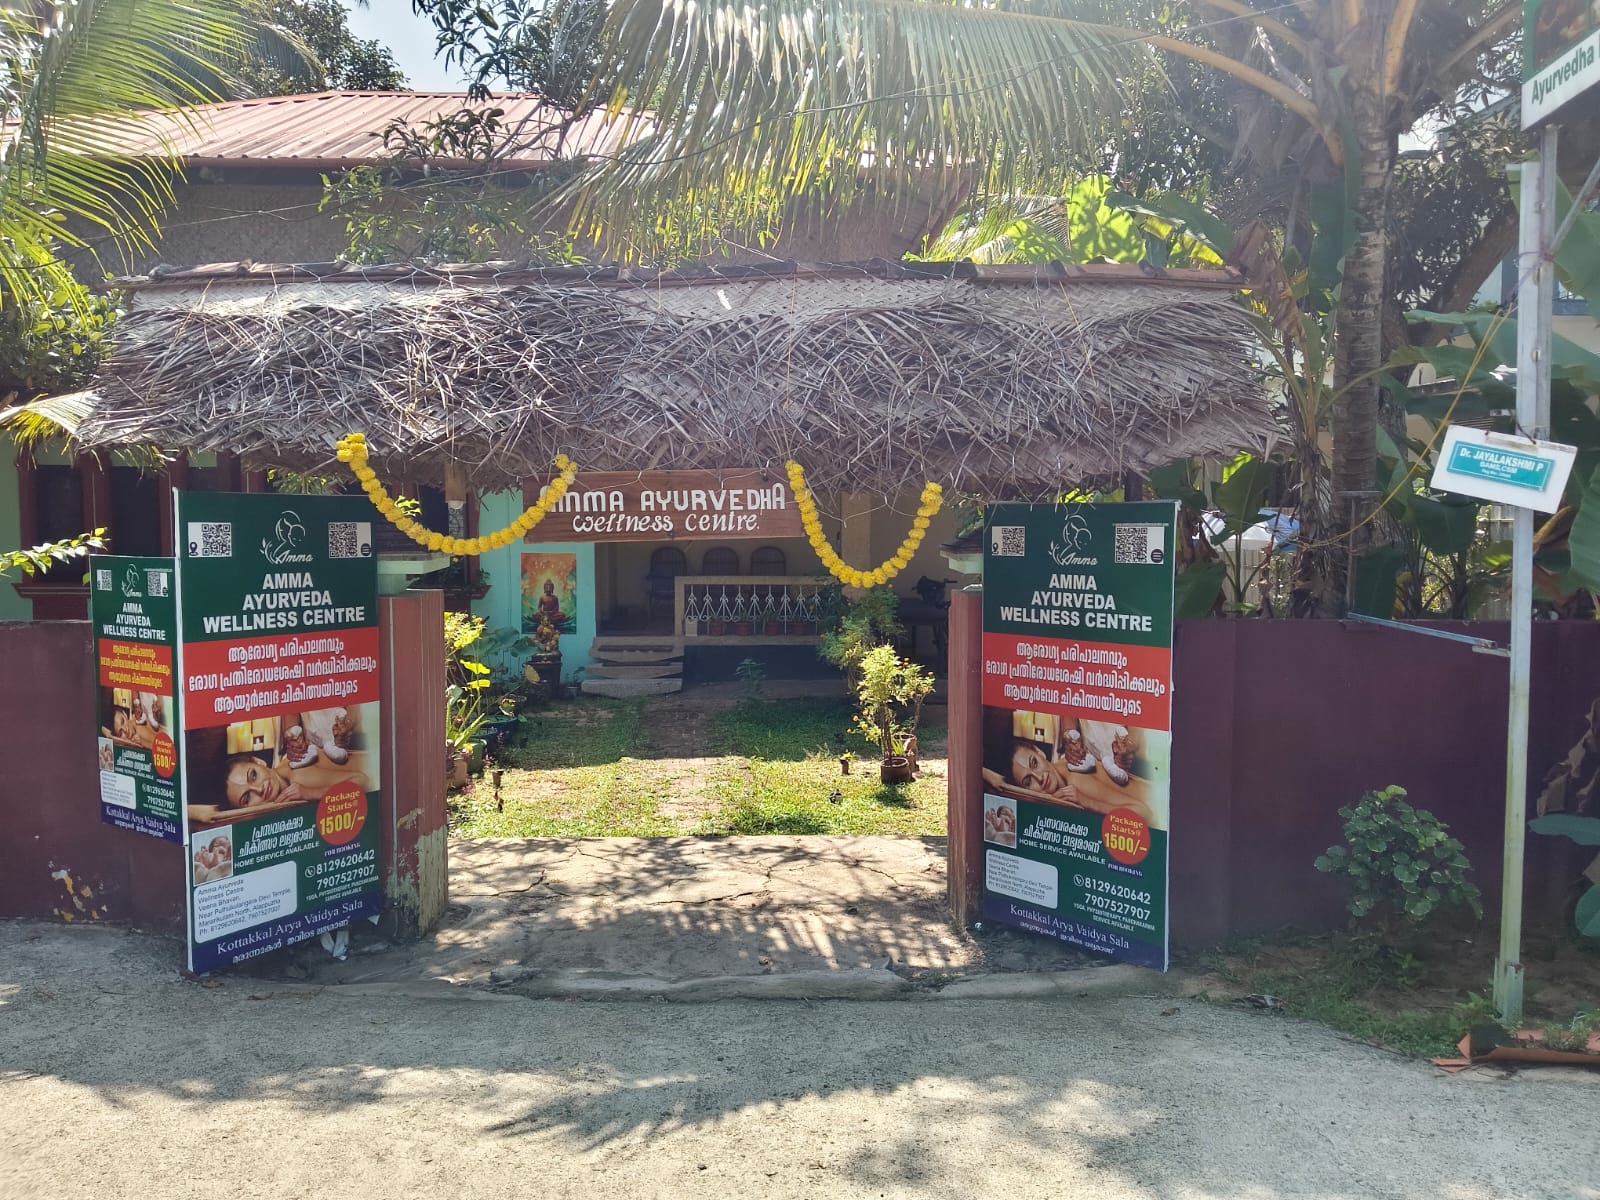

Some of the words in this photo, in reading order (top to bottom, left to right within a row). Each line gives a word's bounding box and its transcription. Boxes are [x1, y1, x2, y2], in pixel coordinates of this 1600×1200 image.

[1531, 45, 1594, 105] Ayurvedha
[1473, 451, 1534, 470] JAYALAKSHMI
[1535, 463, 1544, 472] P
[641, 483, 786, 512] AYURVEDHA
[275, 549, 313, 564] Amma
[1062, 552, 1098, 566] Amma
[262, 572, 313, 590] AMMA
[1049, 574, 1097, 591] AMMA
[122, 602, 143, 614] AMMA
[242, 590, 332, 611] AYURVEDA
[1031, 591, 1116, 611] AYURVEDA
[103, 624, 137, 638] WELLNESS
[138, 627, 166, 640] CENTRE
[116, 614, 151, 627] AYURVEDA
[203, 610, 297, 633] WELLNESS
[302, 606, 365, 625] CENTRE
[1000, 606, 1080, 627] WELLNESS
[1085, 612, 1152, 632] CENTRE
[228, 643, 278, 665] ആരോഗ്യ
[279, 637, 344, 658] പരിപാലനവും
[1016, 643, 1060, 663] ആരോഗ്യ
[1061, 644, 1128, 670] പരിപാലനവും
[189, 673, 218, 691] രോഗ
[219, 660, 304, 691] പ്രതിരോധശേഷി
[985, 660, 1007, 676] രോഗ
[1009, 660, 1085, 685] പ്രതിരോധശേഷി
[325, 789, 361, 804] Package
[163, 822, 176, 834] Sala
[319, 809, 365, 836] 1500/-
[1110, 815, 1144, 829] Package
[234, 860, 255, 870] HOME
[256, 852, 285, 863] SERVICE
[284, 840, 321, 856] AVAILABLE
[1019, 839, 1038, 848] HOME
[1040, 843, 1067, 855] SERVICE
[1068, 850, 1106, 865] AVAILABLE
[1104, 832, 1147, 856] 1500/-
[316, 849, 375, 875] 8129620642
[316, 864, 375, 890] 7907527907
[1084, 877, 1151, 905] 8129620642
[1084, 893, 1151, 921] 7907527907
[217, 927, 272, 954] Kottakkal
[275, 920, 301, 938] Arya
[304, 907, 339, 926] Vaidya
[342, 900, 363, 914] Sala
[1010, 904, 1050, 924] Kottakkal
[1052, 917, 1074, 934] Arya
[1076, 923, 1107, 944] Vaidya
[1109, 934, 1130, 949] Sala
